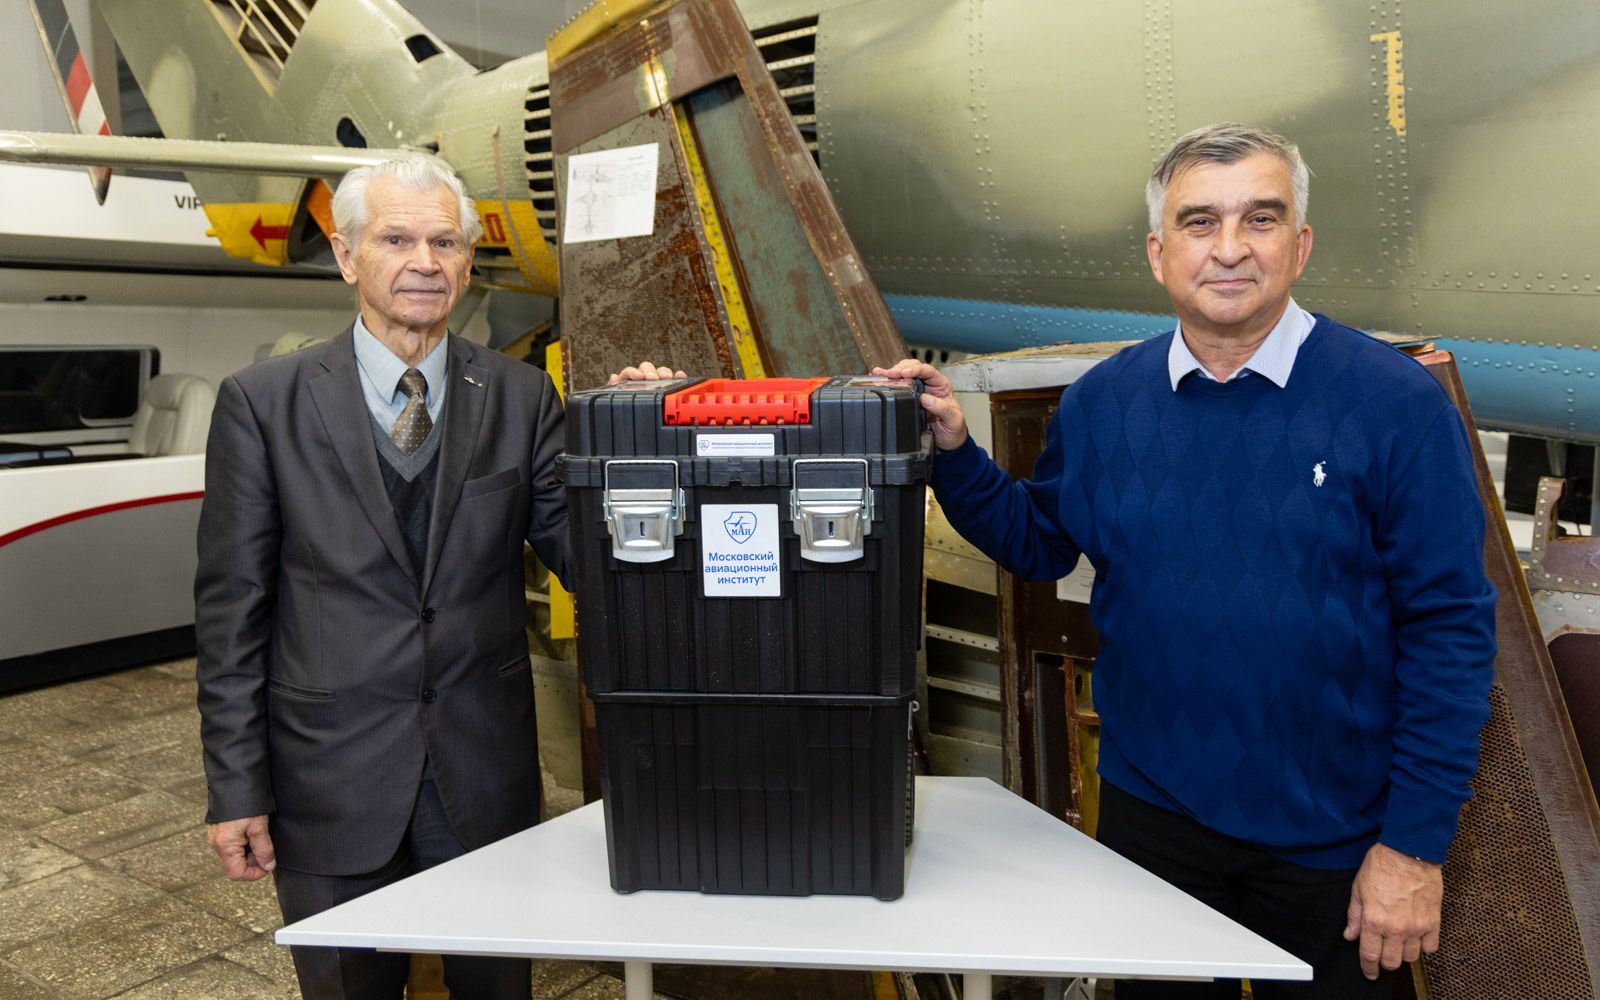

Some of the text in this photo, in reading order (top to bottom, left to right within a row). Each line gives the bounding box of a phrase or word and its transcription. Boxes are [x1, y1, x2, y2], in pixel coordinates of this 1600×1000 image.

[731, 524, 751, 536] МАИ
[708, 551, 774, 562] Московский
[704, 562, 778, 574] авиационный
[717, 575, 766, 586] институт
